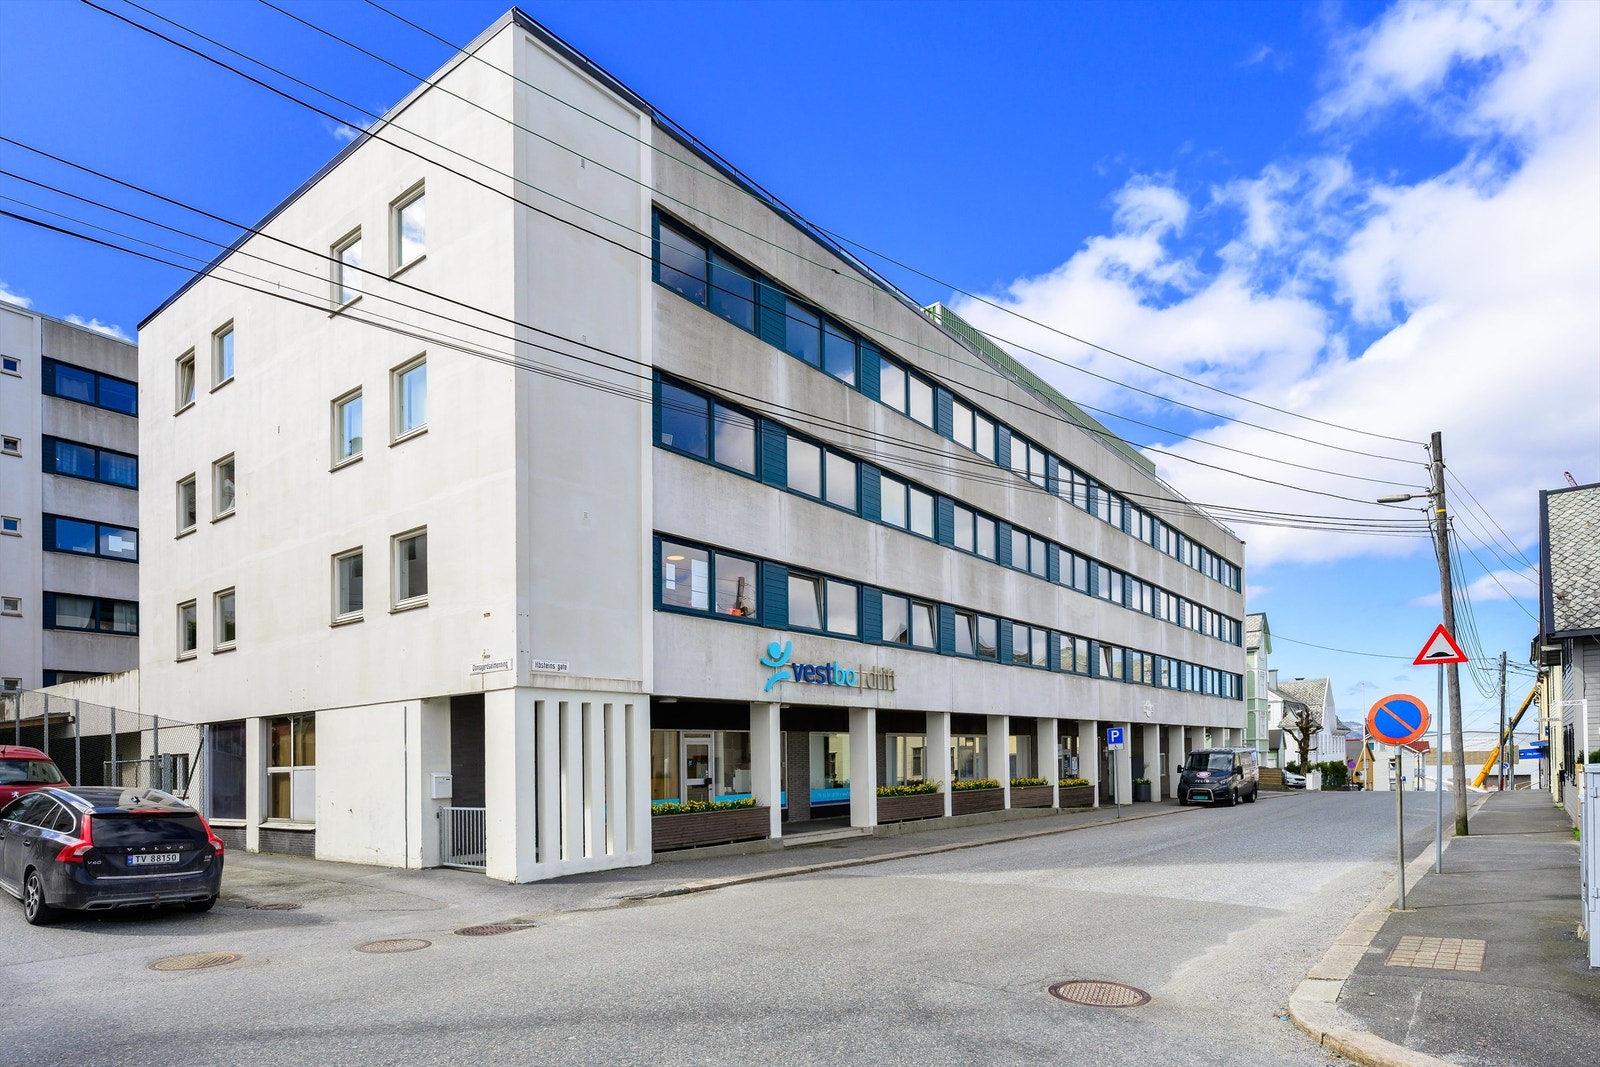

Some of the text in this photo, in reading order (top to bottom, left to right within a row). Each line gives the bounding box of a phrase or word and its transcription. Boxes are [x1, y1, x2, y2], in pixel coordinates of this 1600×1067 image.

[557, 663, 568, 672] gate
[792, 660, 857, 688] vestbo
[1111, 729, 1120, 743] P
[135, 854, 177, 863] TV 88150
